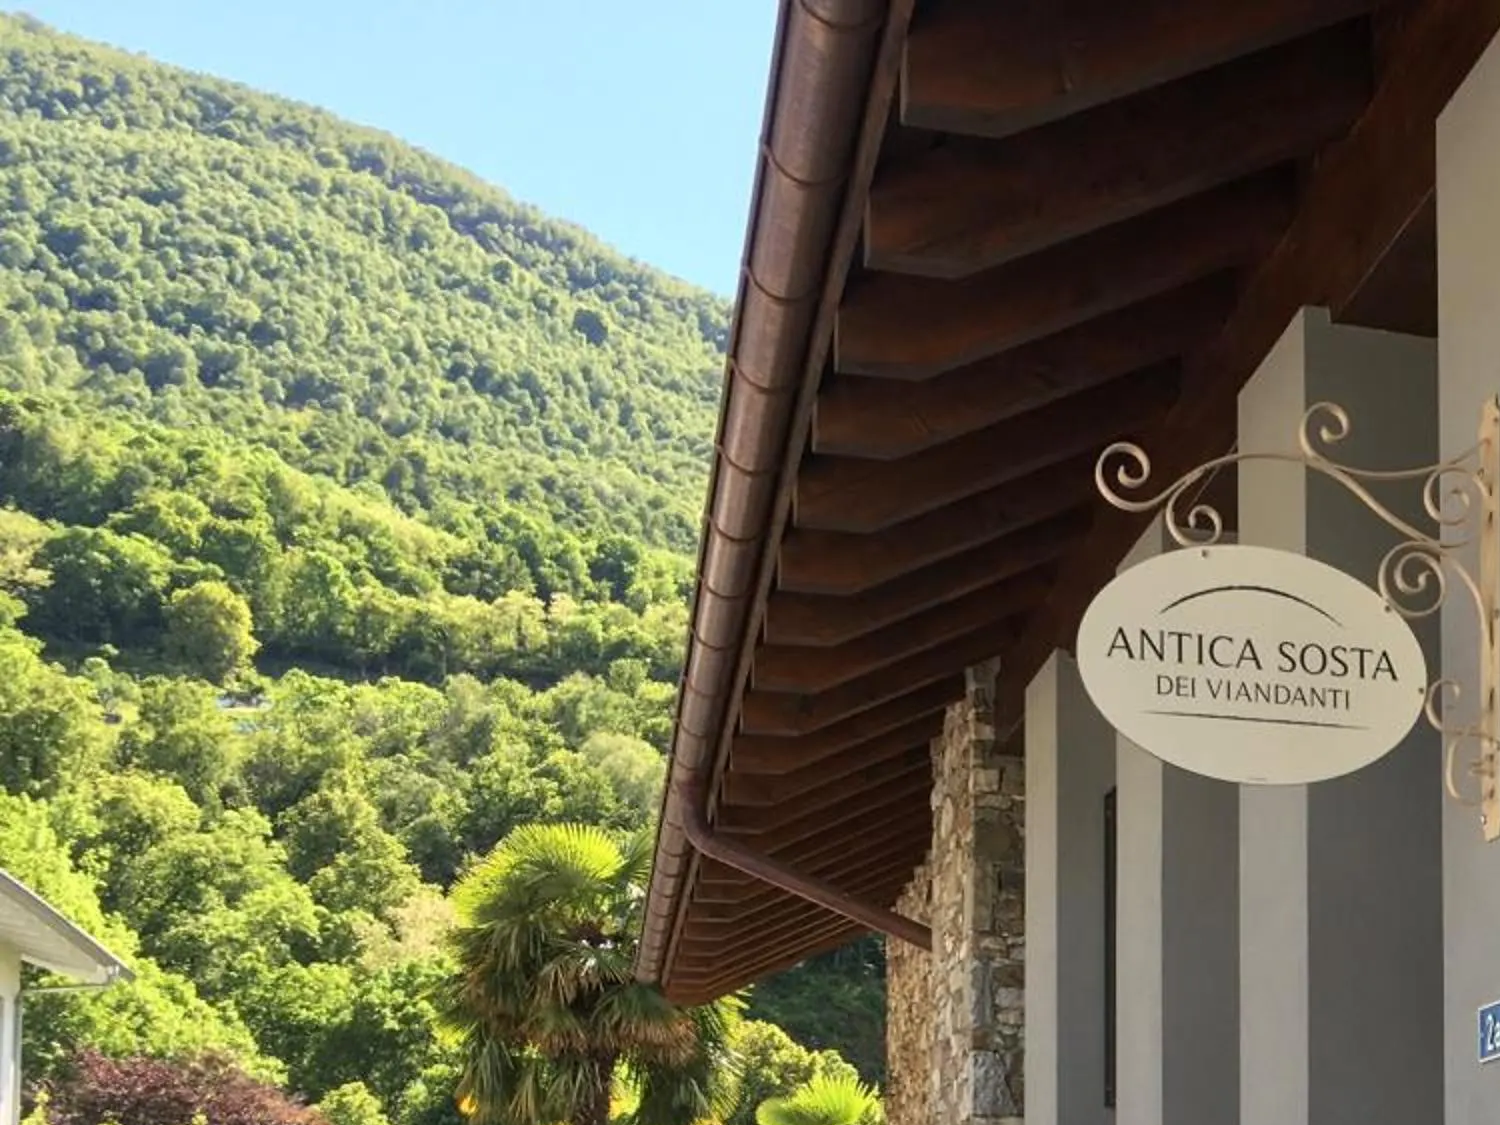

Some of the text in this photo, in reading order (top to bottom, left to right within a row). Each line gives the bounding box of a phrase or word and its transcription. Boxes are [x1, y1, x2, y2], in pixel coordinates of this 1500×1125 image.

[1106, 626, 1399, 682] ANTICA SOSTA
[1156, 674, 1351, 711] DEI VIANDANTI
